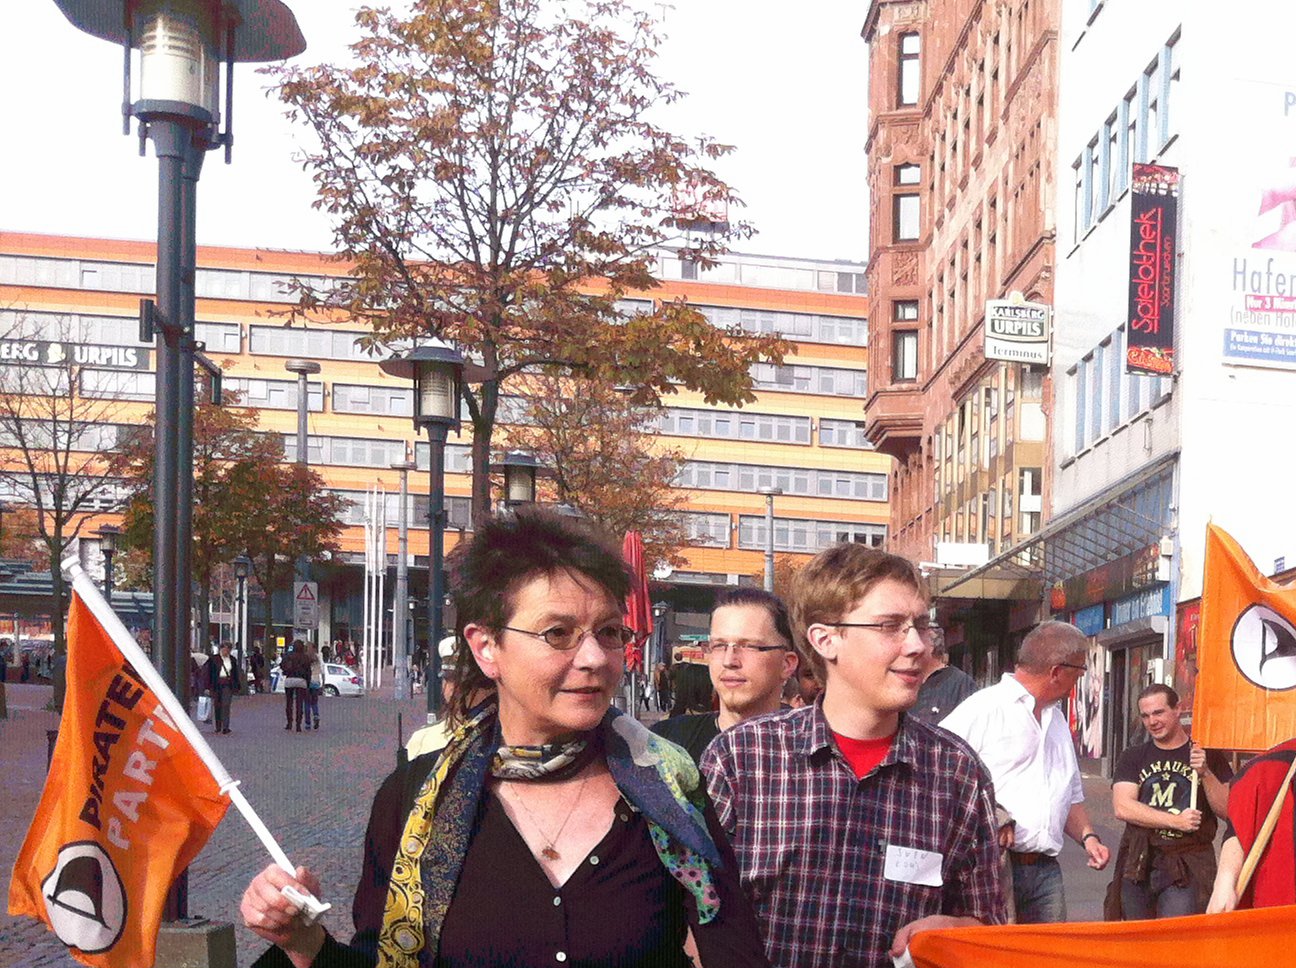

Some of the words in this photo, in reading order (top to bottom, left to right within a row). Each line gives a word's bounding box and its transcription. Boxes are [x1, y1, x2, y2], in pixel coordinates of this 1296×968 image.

[1131, 207, 1157, 333] Spielothek
[1230, 305, 1271, 326] (neben
[994, 318, 1042, 336] URPILS
[74, 345, 138, 367] URPILS
[1149, 782, 1177, 807] M
